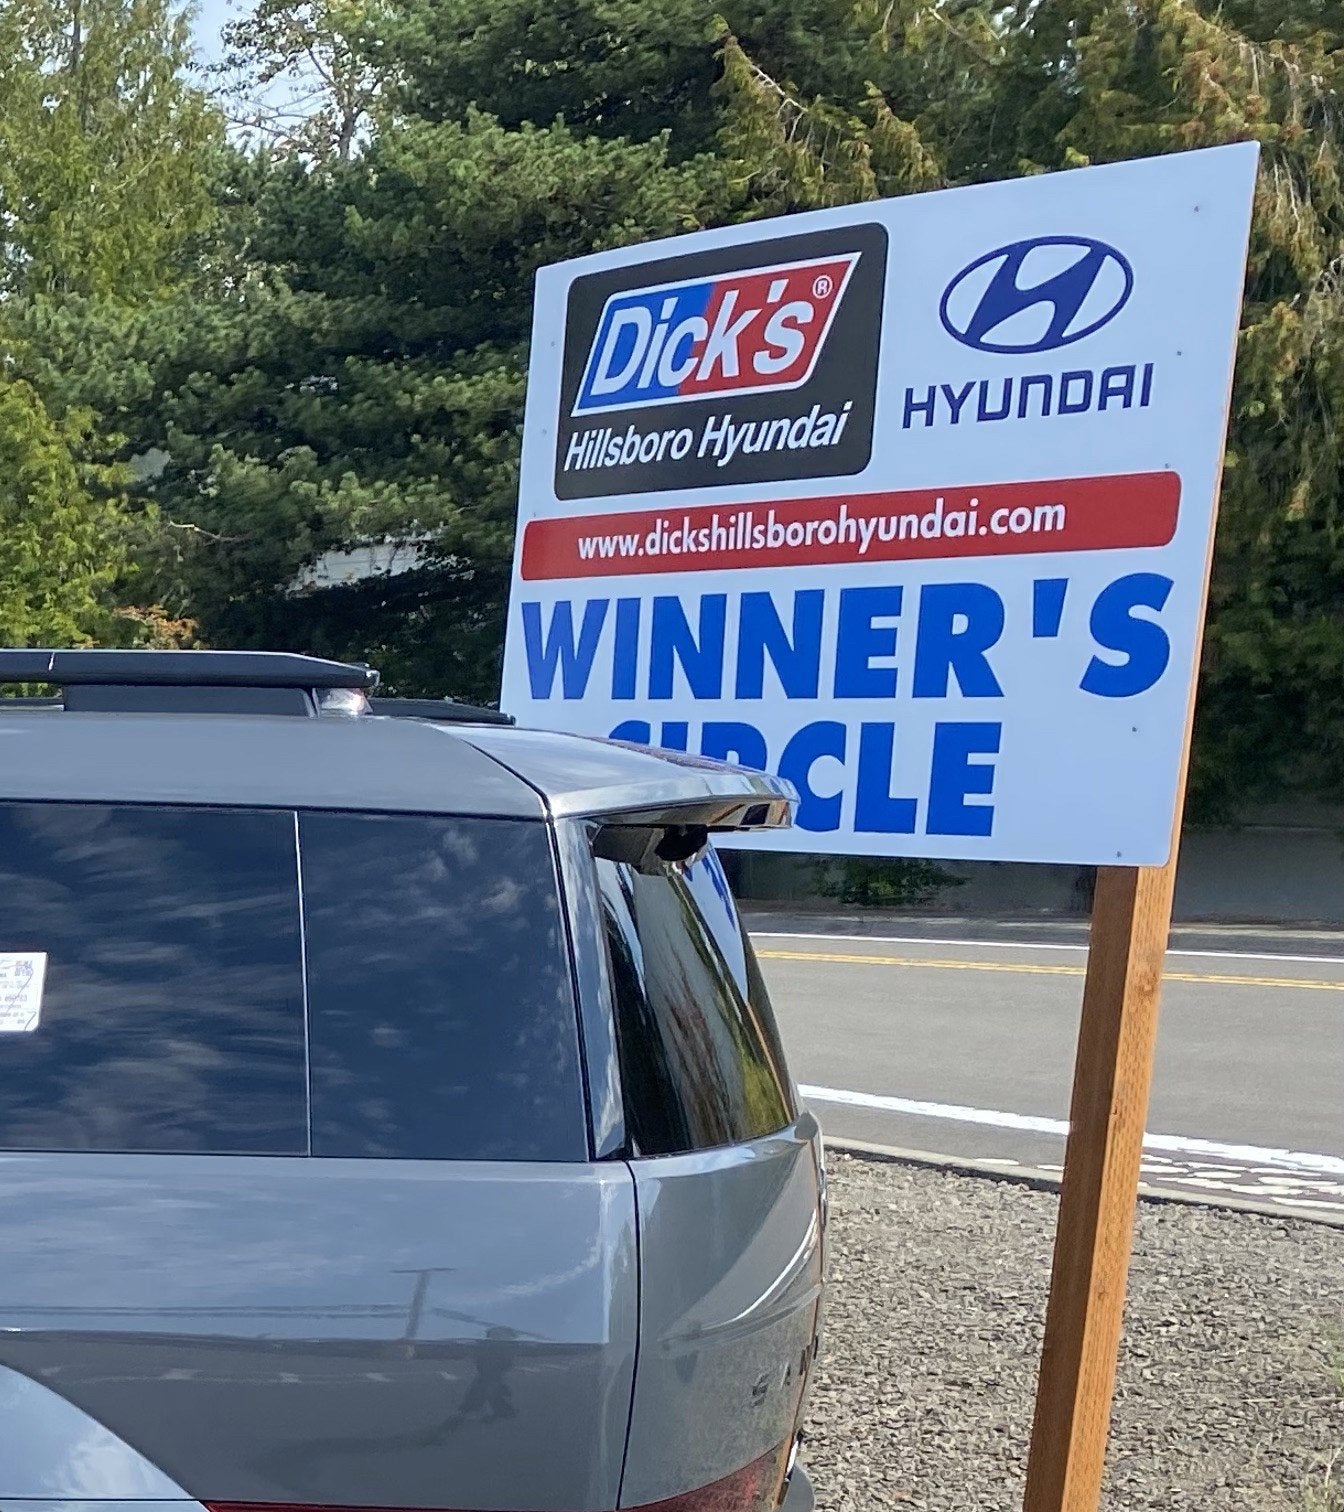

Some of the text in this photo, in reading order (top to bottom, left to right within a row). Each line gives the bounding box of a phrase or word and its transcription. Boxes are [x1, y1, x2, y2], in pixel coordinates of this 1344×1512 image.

[902, 363, 1154, 429] HYUNDAI
[563, 400, 854, 472] Hillsboro Hyundai
[578, 497, 1066, 559] www.dickshillsborohyundai.com
[521, 572, 1175, 700] WINNER'S
[609, 720, 1002, 836] CLE
